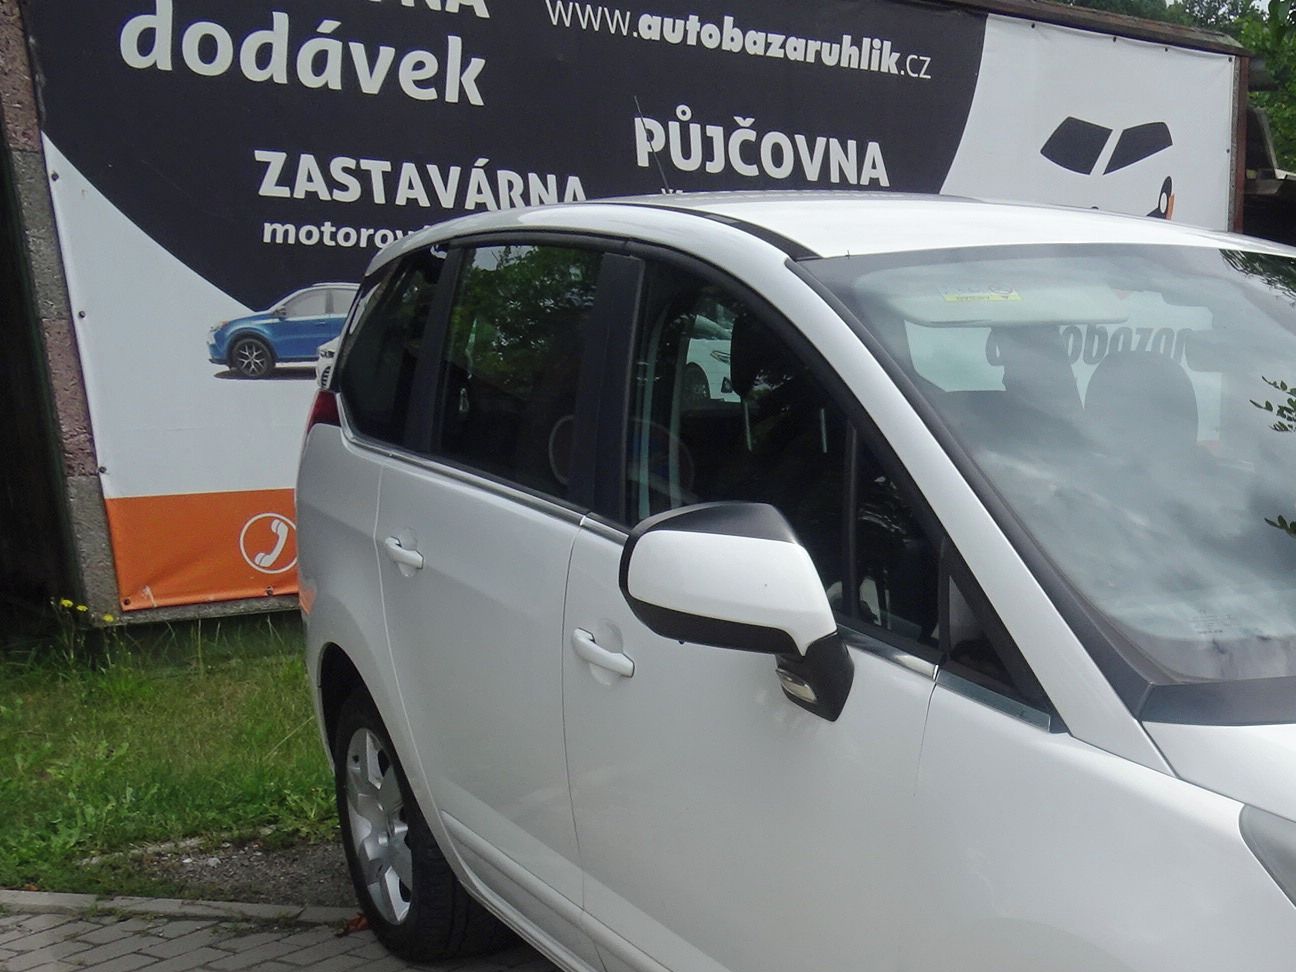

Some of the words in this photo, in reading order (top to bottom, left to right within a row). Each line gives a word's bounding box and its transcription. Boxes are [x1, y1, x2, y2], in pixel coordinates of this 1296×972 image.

[120, 0, 487, 106] dodávek
[546, 0, 932, 79] www.autobazaruhlik.cz
[254, 149, 587, 212] ZASTAVÁRNA
[634, 104, 890, 187] PŮJČOVNA
